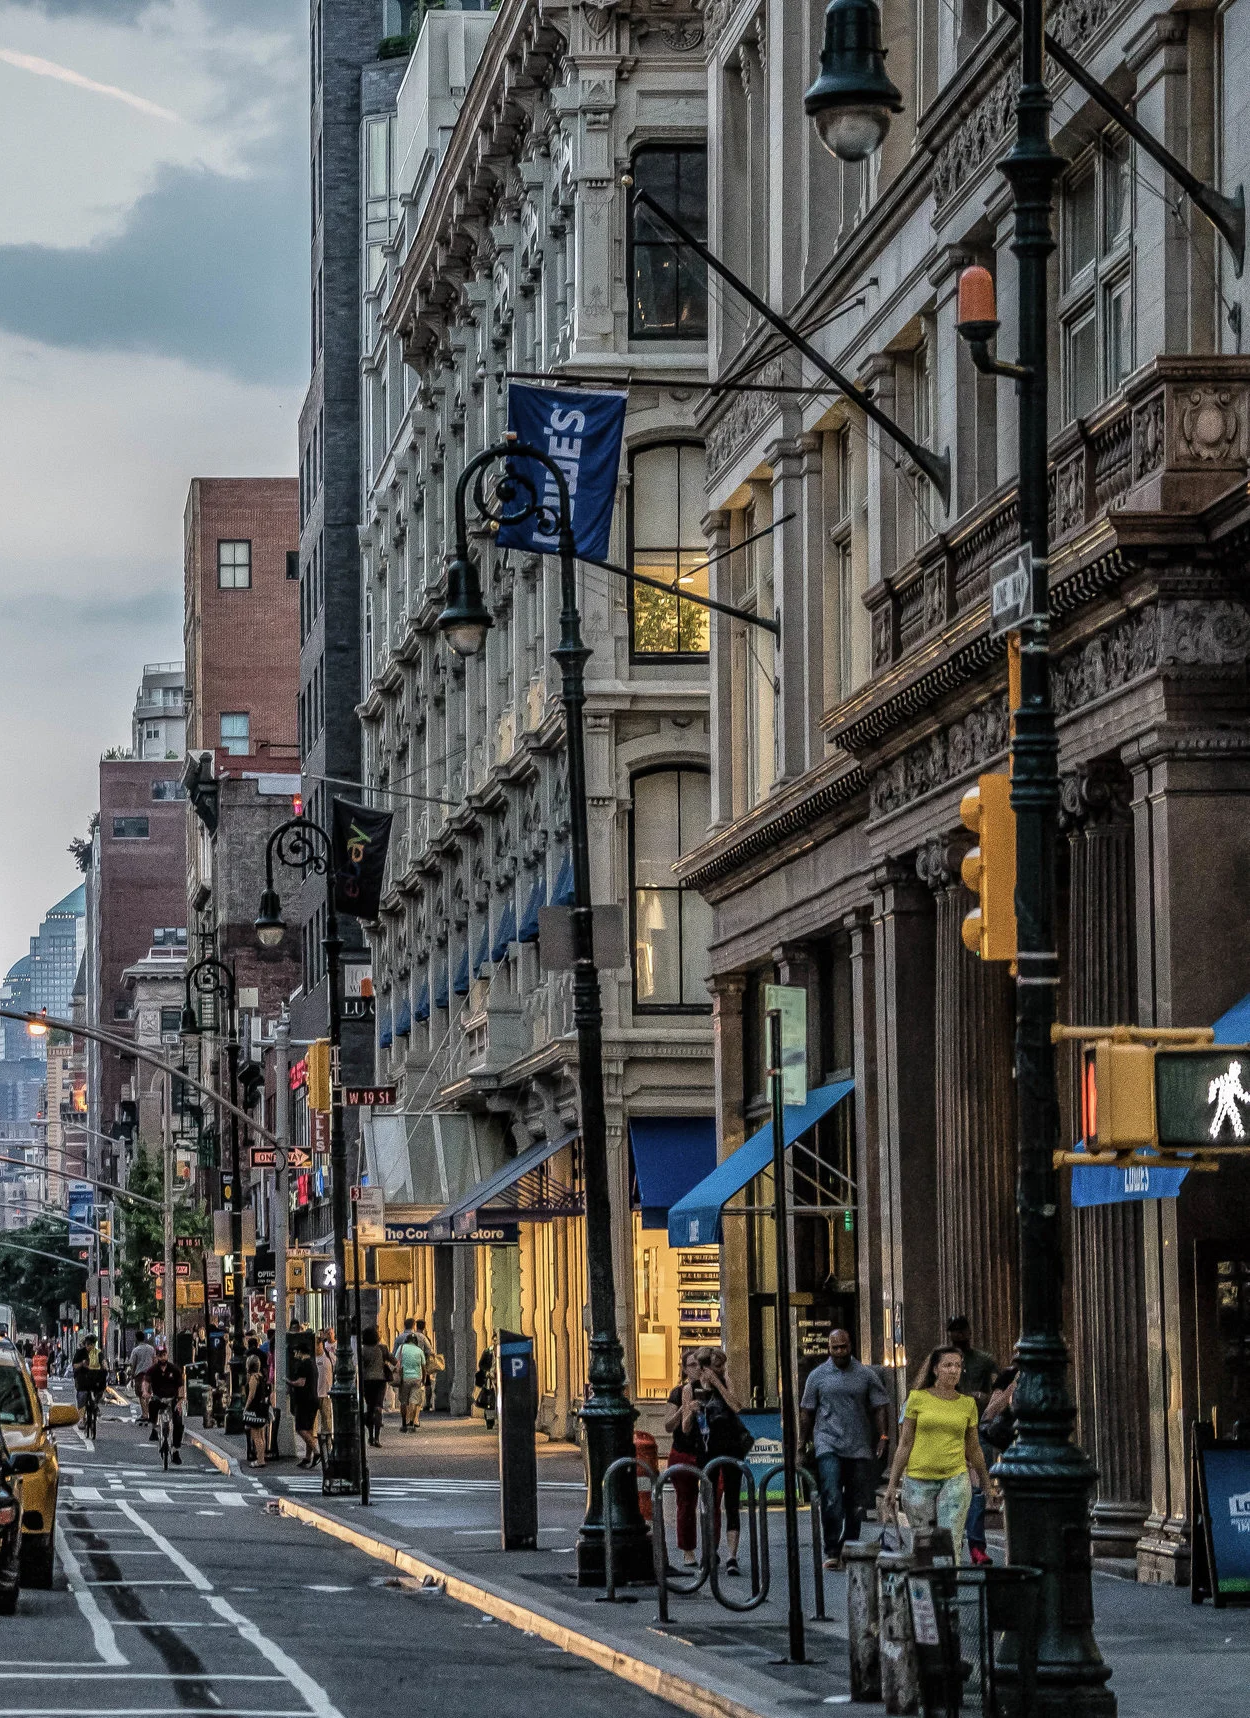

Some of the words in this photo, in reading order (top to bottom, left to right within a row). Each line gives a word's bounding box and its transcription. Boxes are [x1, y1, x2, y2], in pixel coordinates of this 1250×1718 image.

[349, 1091, 359, 1104] W
[364, 1090, 374, 1104] 19
[379, 1090, 390, 1104] St
[511, 1357, 524, 1377] P
[754, 1444, 779, 1453] OWE'S
